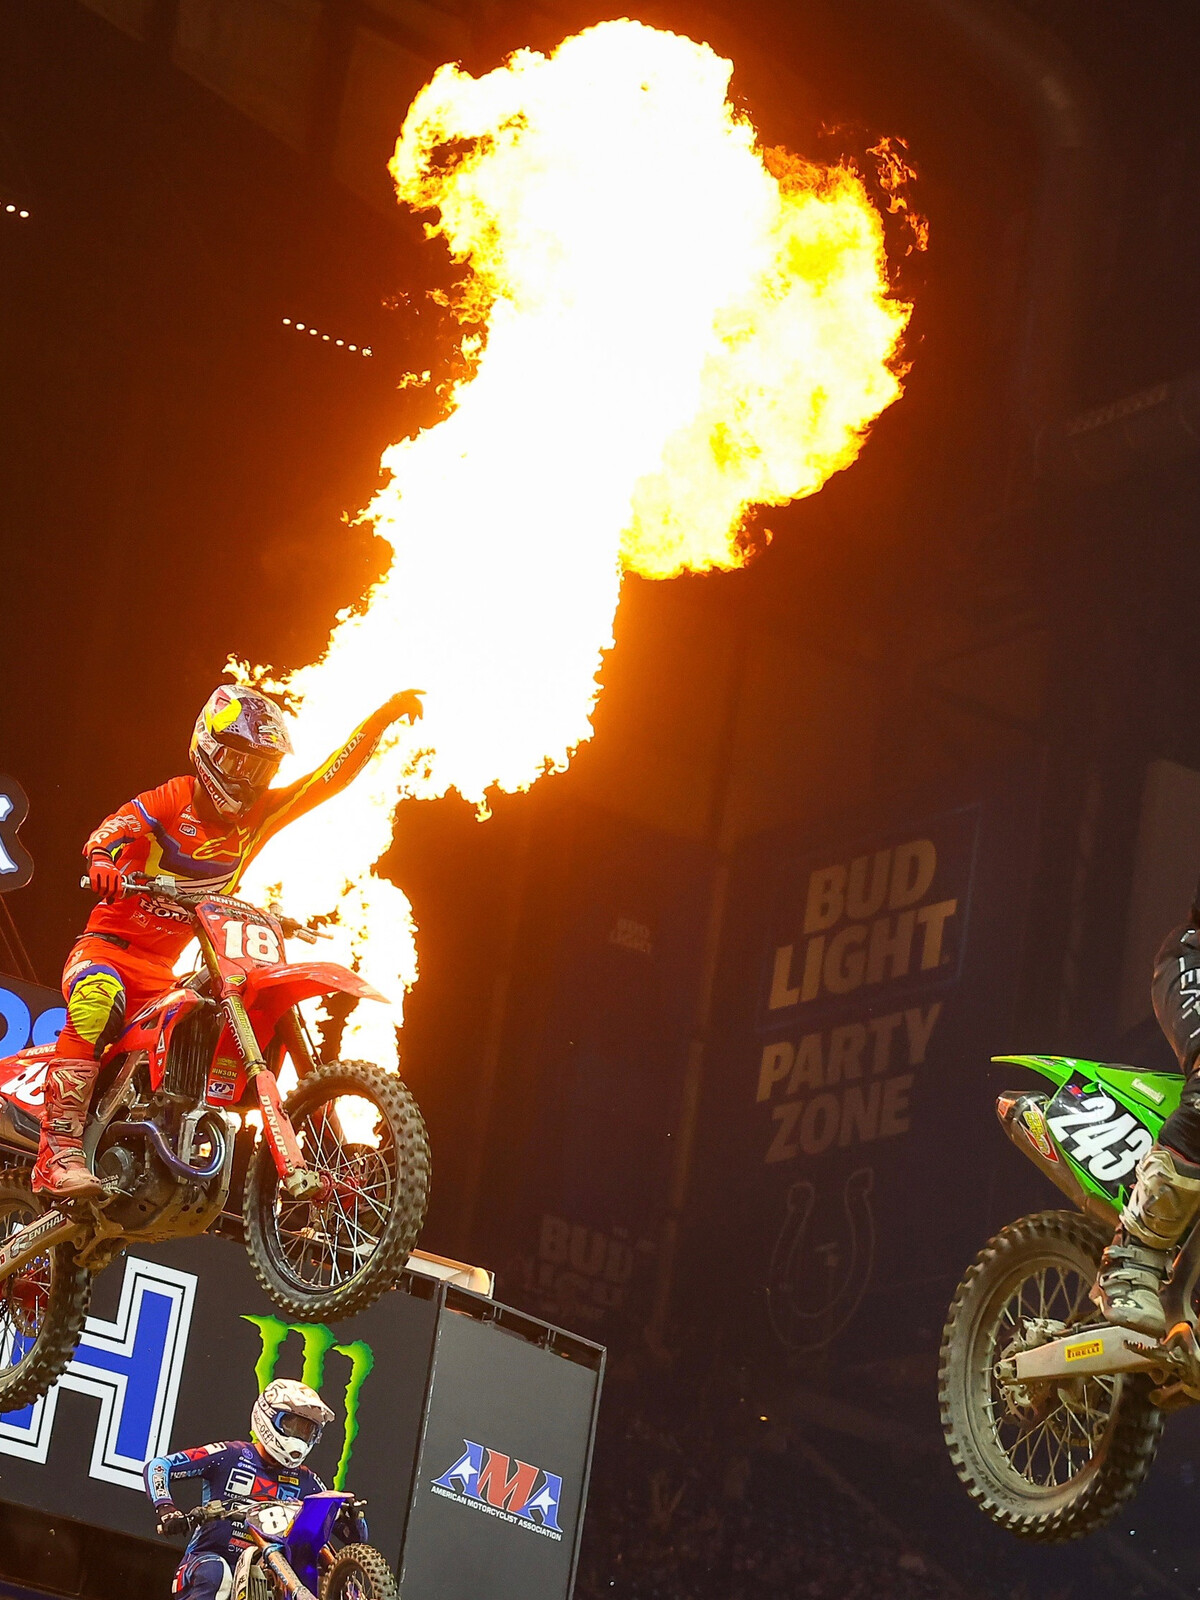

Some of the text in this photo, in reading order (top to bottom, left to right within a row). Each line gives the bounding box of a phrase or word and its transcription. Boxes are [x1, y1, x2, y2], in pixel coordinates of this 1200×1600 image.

[323, 732, 366, 784] HONDA
[209, 895, 253, 911] RENTHAL
[803, 839, 938, 934] BUD
[222, 920, 280, 964] 18
[768, 899, 958, 1011] LIGHT
[756, 1003, 942, 1103] PARTY
[260, 1095, 289, 1157] DUNLOP
[763, 1074, 914, 1165] ZONE
[1046, 1096, 1153, 1182] 243
[1067, 1342, 1100, 1359] PIRELLI
[225, 1468, 301, 1501] FXR
[430, 1438, 563, 1532] AMA
[430, 1485, 562, 1542] AMERICAN MOTORCYCLIST ASSOCIATION
